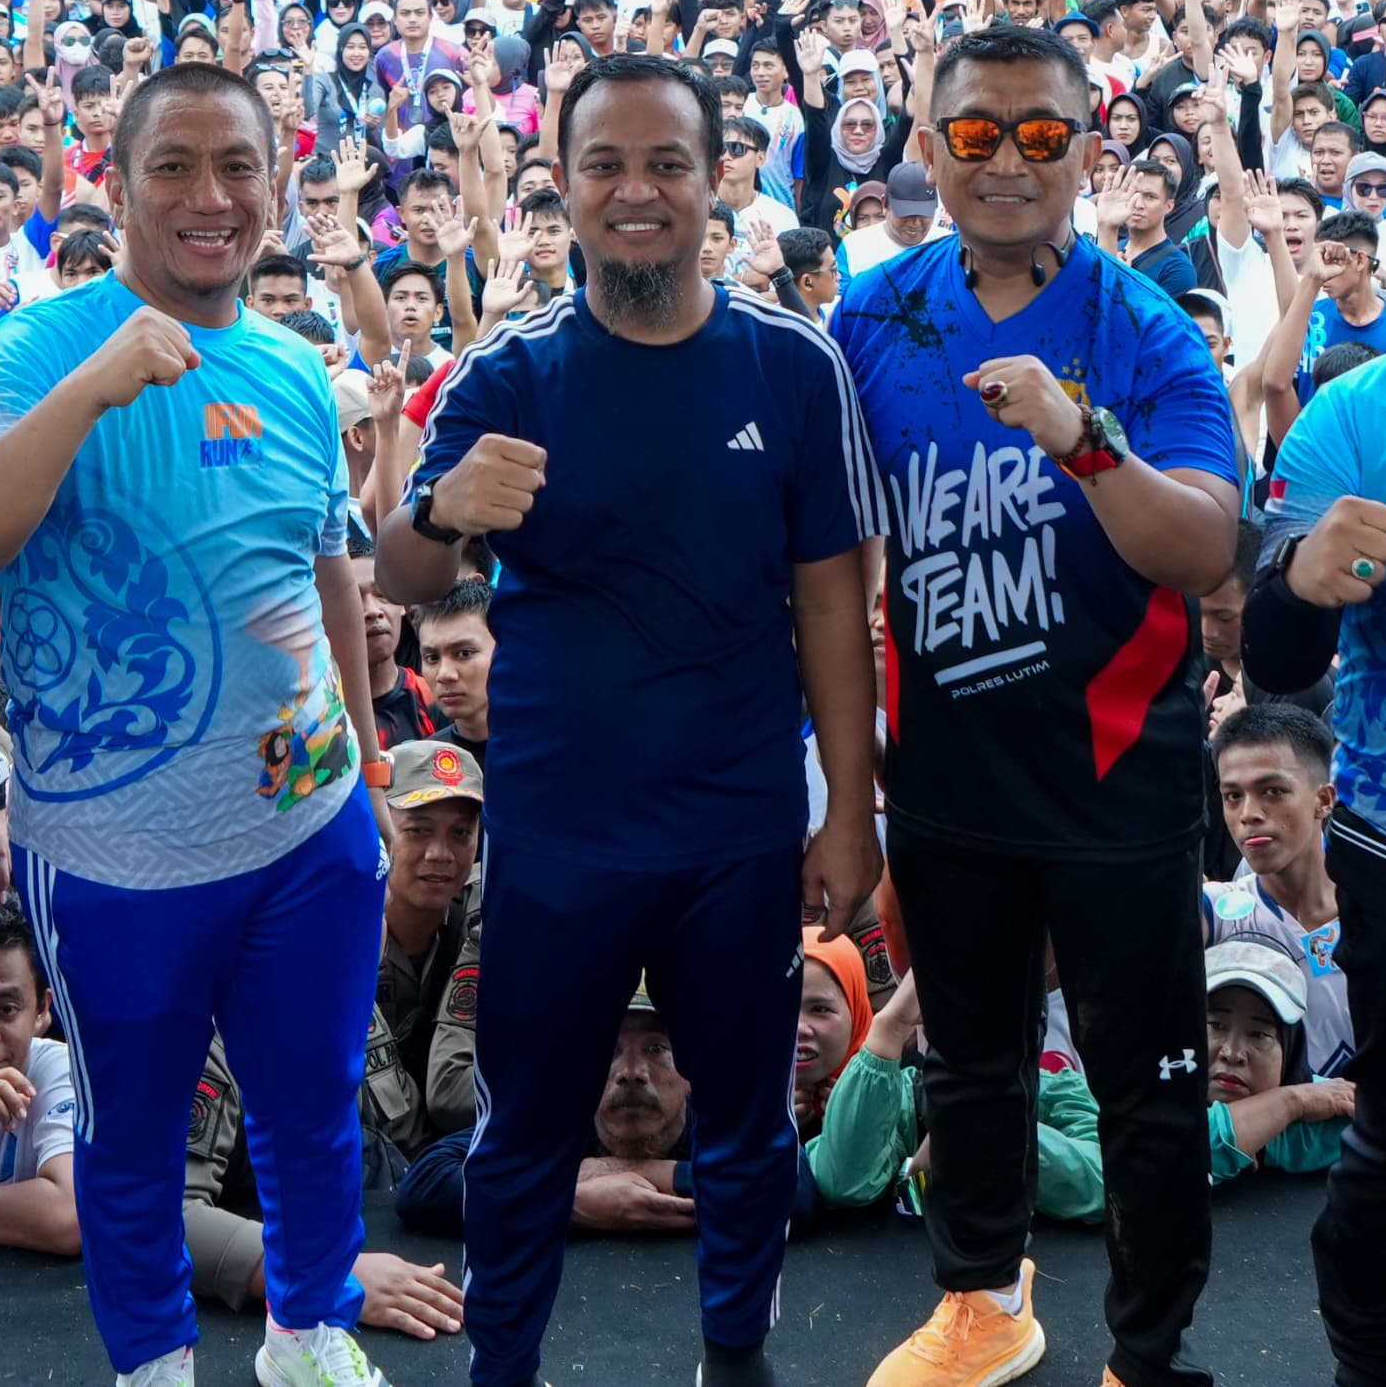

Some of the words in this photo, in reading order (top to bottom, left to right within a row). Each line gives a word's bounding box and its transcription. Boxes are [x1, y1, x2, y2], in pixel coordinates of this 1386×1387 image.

[200, 439, 238, 467] RUN
[901, 524, 1065, 656] TEAM!
[951, 674, 1005, 699] POLRES
[1006, 660, 1051, 683] LUTIM
